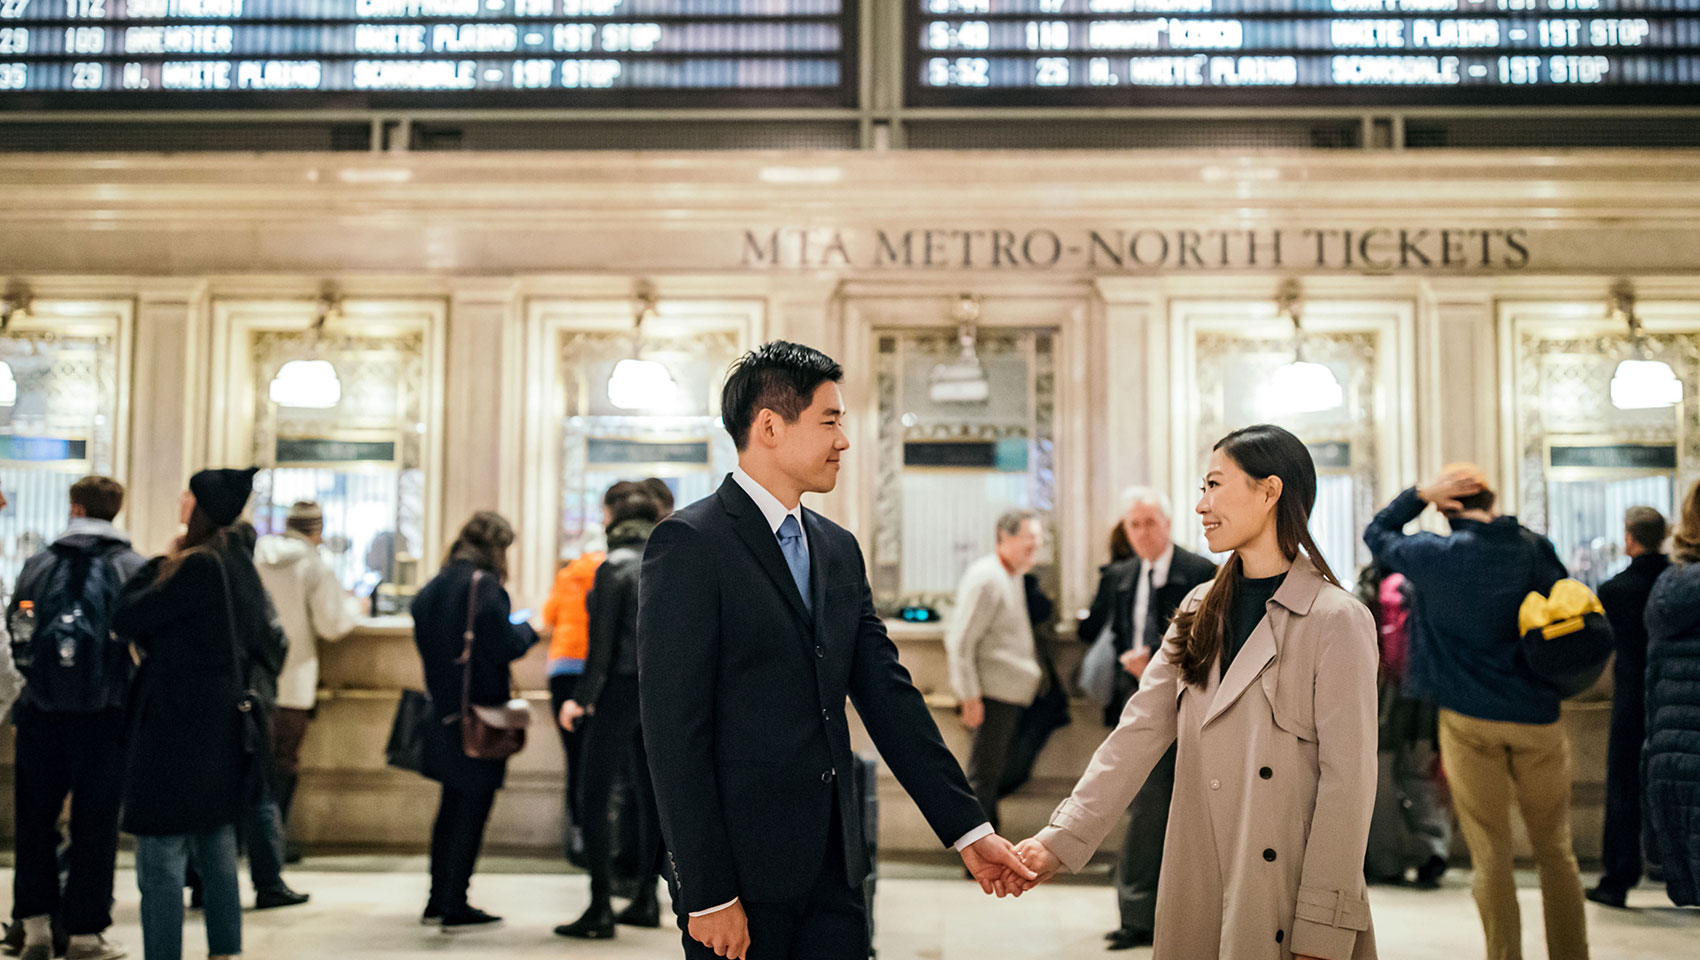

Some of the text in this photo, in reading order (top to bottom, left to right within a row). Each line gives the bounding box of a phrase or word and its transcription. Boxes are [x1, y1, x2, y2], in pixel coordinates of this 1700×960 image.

[553, 24, 597, 52] 1ST
[602, 24, 662, 52] STOP
[1538, 19, 1581, 47] 1ST
[1590, 19, 1649, 47] STOP
[512, 59, 555, 88] 1ST
[561, 59, 621, 88] STOP
[1498, 55, 1541, 84] 1ST
[1549, 55, 1609, 84] STOP
[742, 228, 1530, 269] MTA METRO-NORTH TICKETS
